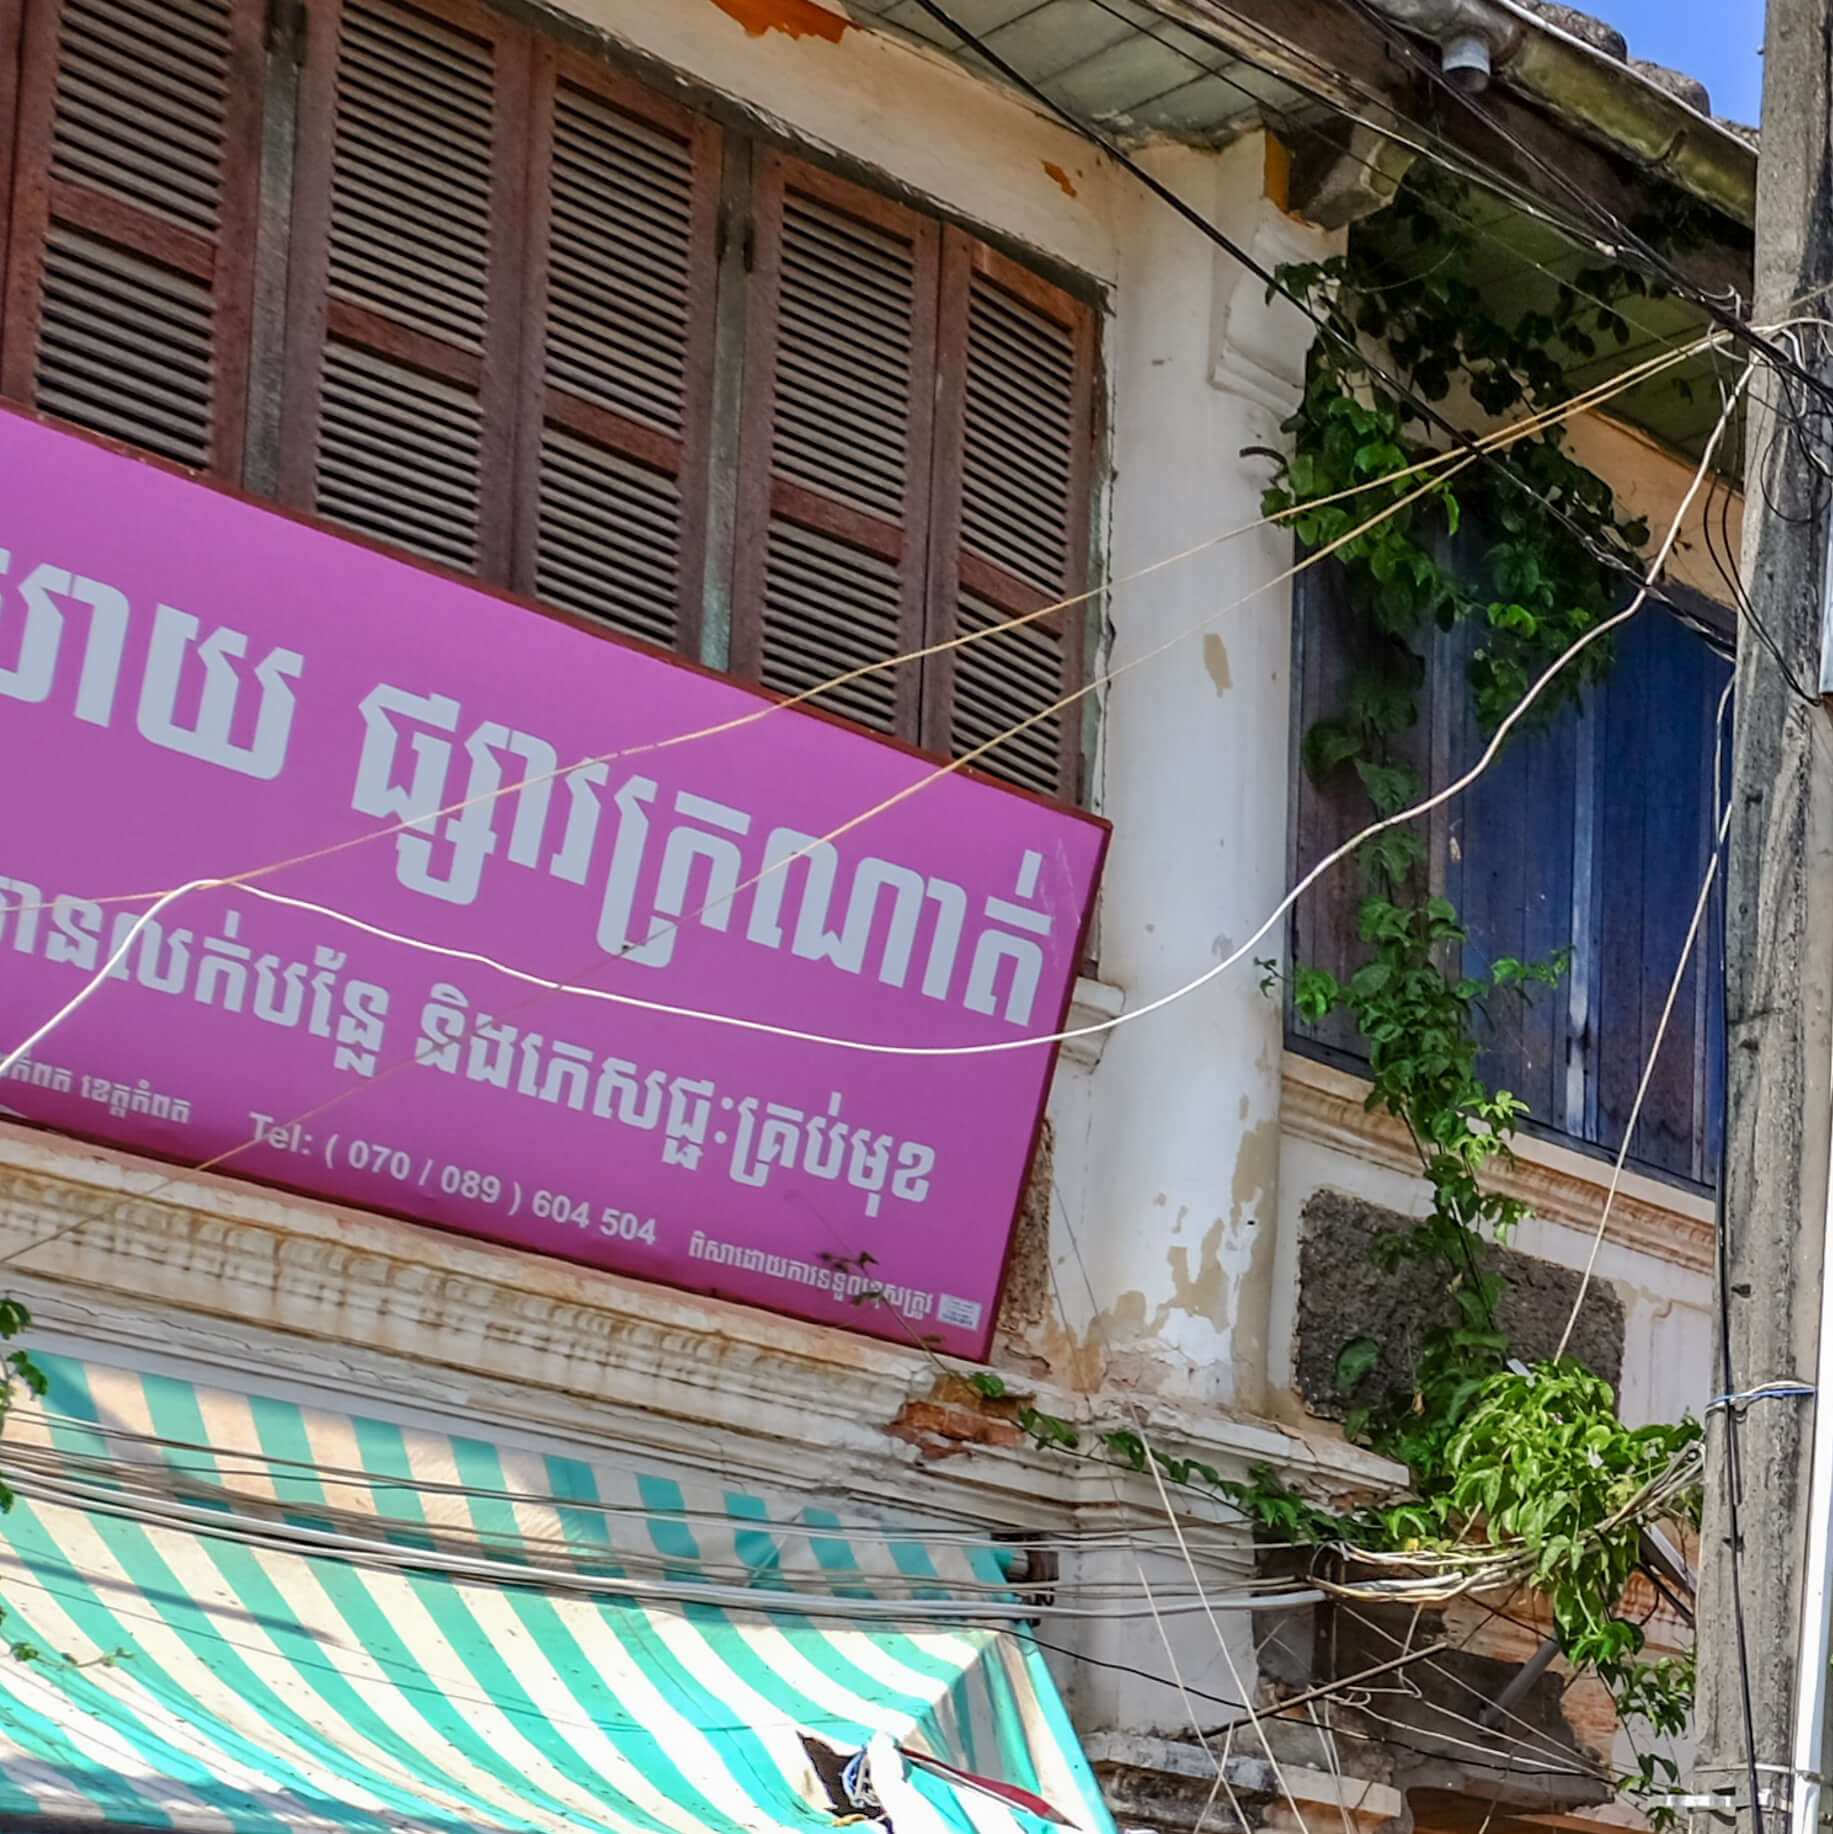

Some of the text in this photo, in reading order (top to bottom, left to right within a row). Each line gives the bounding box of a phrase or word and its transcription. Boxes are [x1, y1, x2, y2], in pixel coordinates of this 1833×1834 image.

[0, 875, 391, 1077] ានលក់បន្លែ
[249, 1112, 313, 1156] Tel:
[347, 1140, 411, 1180] 070
[440, 1165, 501, 1204] 089
[532, 1189, 591, 1230] 604
[599, 1207, 657, 1245] 504
